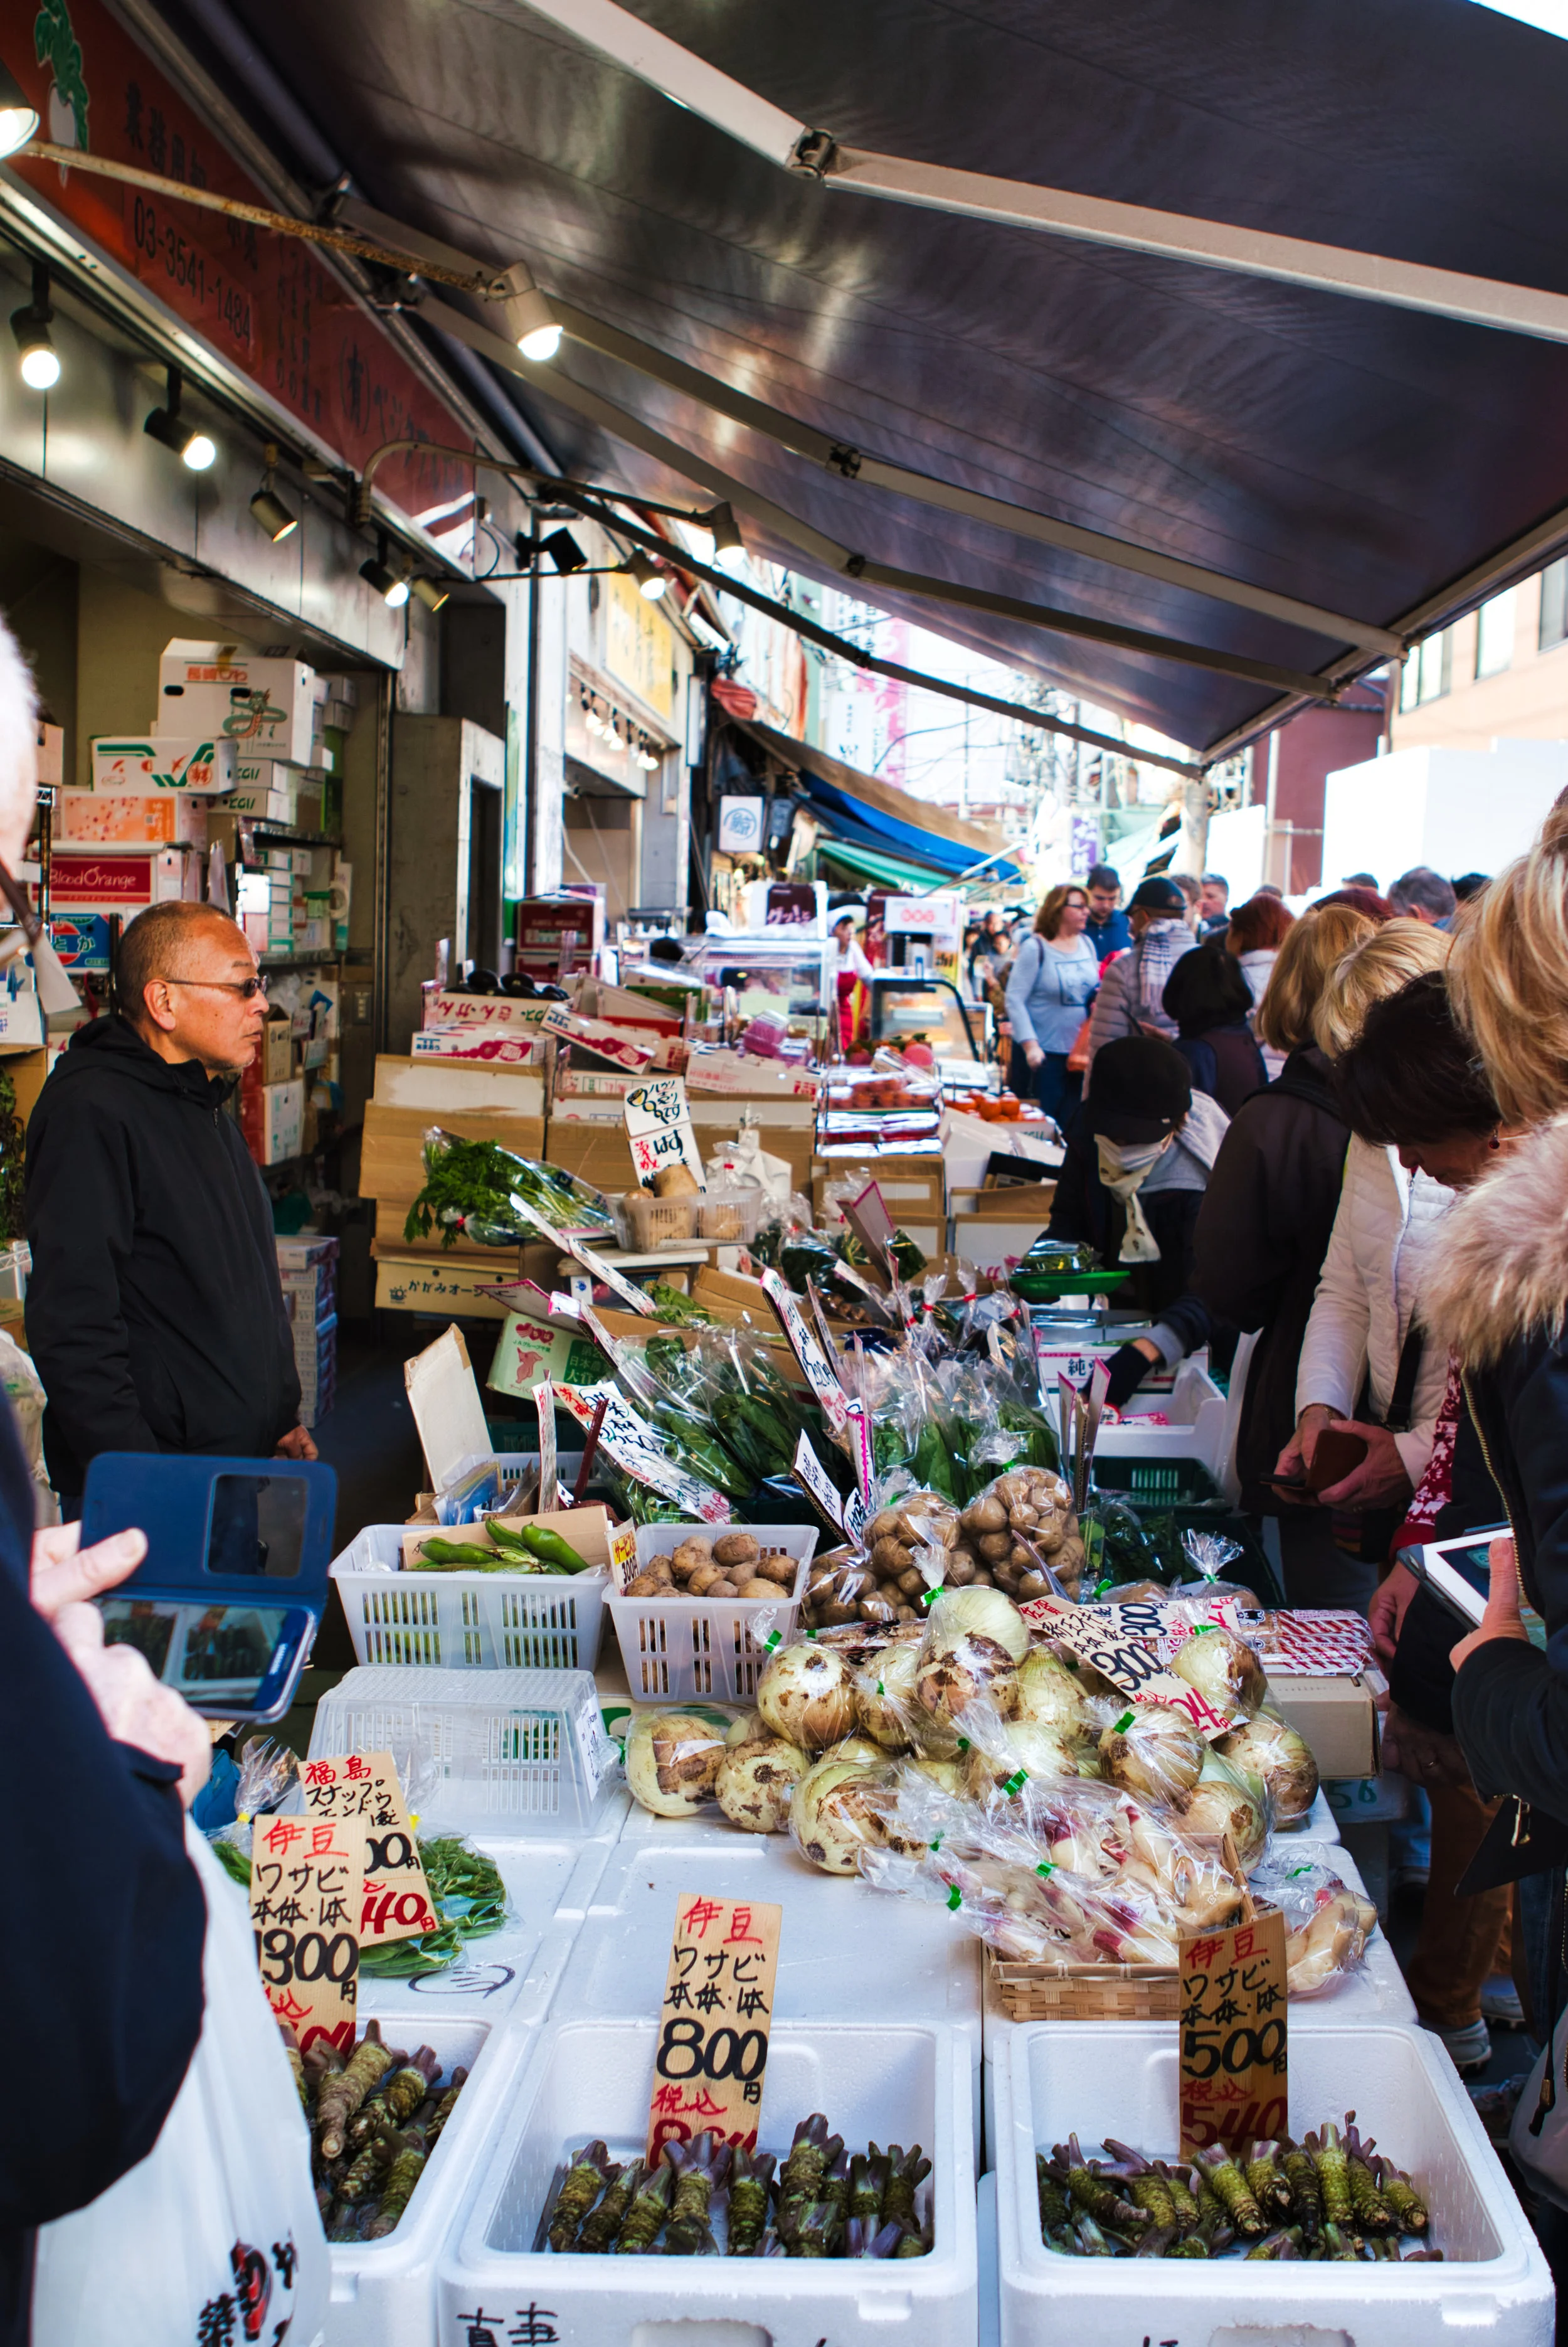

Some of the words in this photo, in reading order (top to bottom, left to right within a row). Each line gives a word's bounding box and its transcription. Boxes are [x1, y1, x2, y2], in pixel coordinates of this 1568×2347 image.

[134, 196, 252, 348] 03-3541-1484
[1019, 1599, 1064, 1620] 佐賀
[305, 1755, 373, 1786] 福島
[306, 1779, 386, 1807] スナップ
[262, 1819, 350, 1859] 伊豆
[256, 1862, 349, 1895] ワサビ
[682, 1895, 763, 1945] 伊豆
[674, 1945, 766, 1982] ワサビ
[1185, 1927, 1268, 1969] 伊豆
[1183, 1958, 1271, 2002] ワサビ
[650, 2082, 728, 2117] 税込
[1180, 2078, 1256, 2102] 税込
